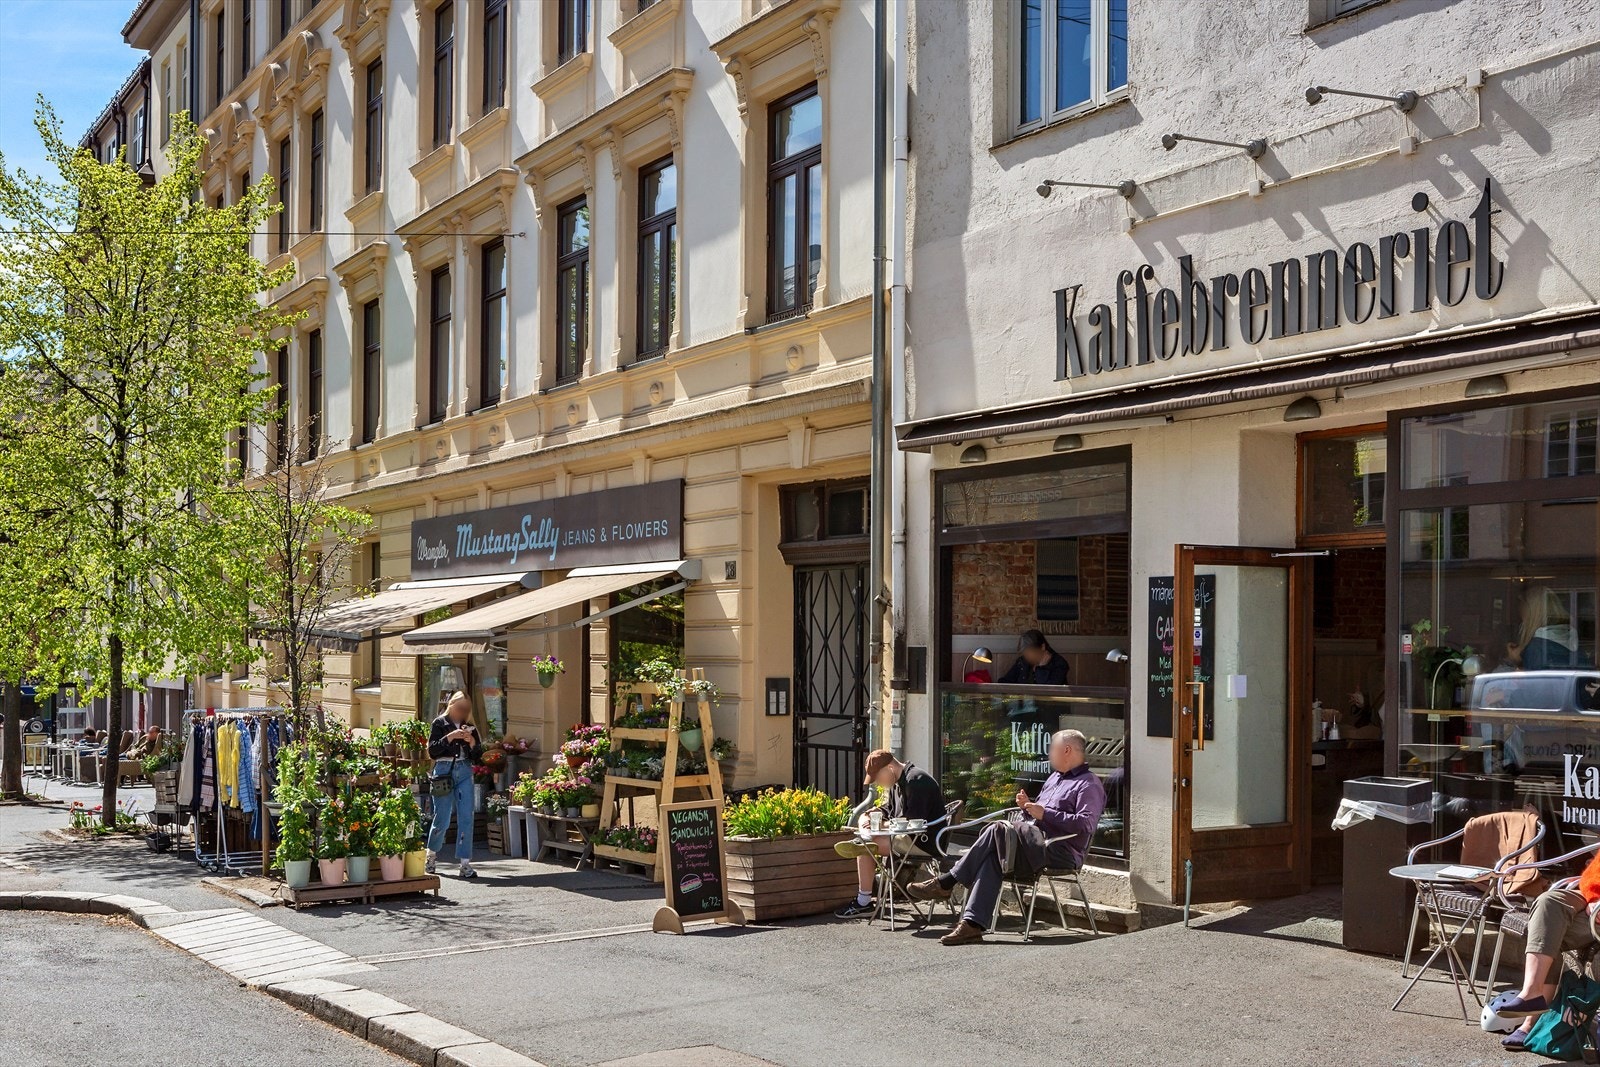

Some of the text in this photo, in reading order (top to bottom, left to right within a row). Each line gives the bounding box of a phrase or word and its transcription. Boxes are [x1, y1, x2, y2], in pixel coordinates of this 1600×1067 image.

[1053, 178, 1504, 381] Kaffebrenneriet
[417, 535, 449, 568] Wrangler
[562, 529, 595, 546] JEANS
[600, 527, 607, 541] &
[612, 519, 669, 540] FLOWERS
[1011, 722, 1052, 755] Kaffe
[672, 809, 709, 824] VEGANSK
